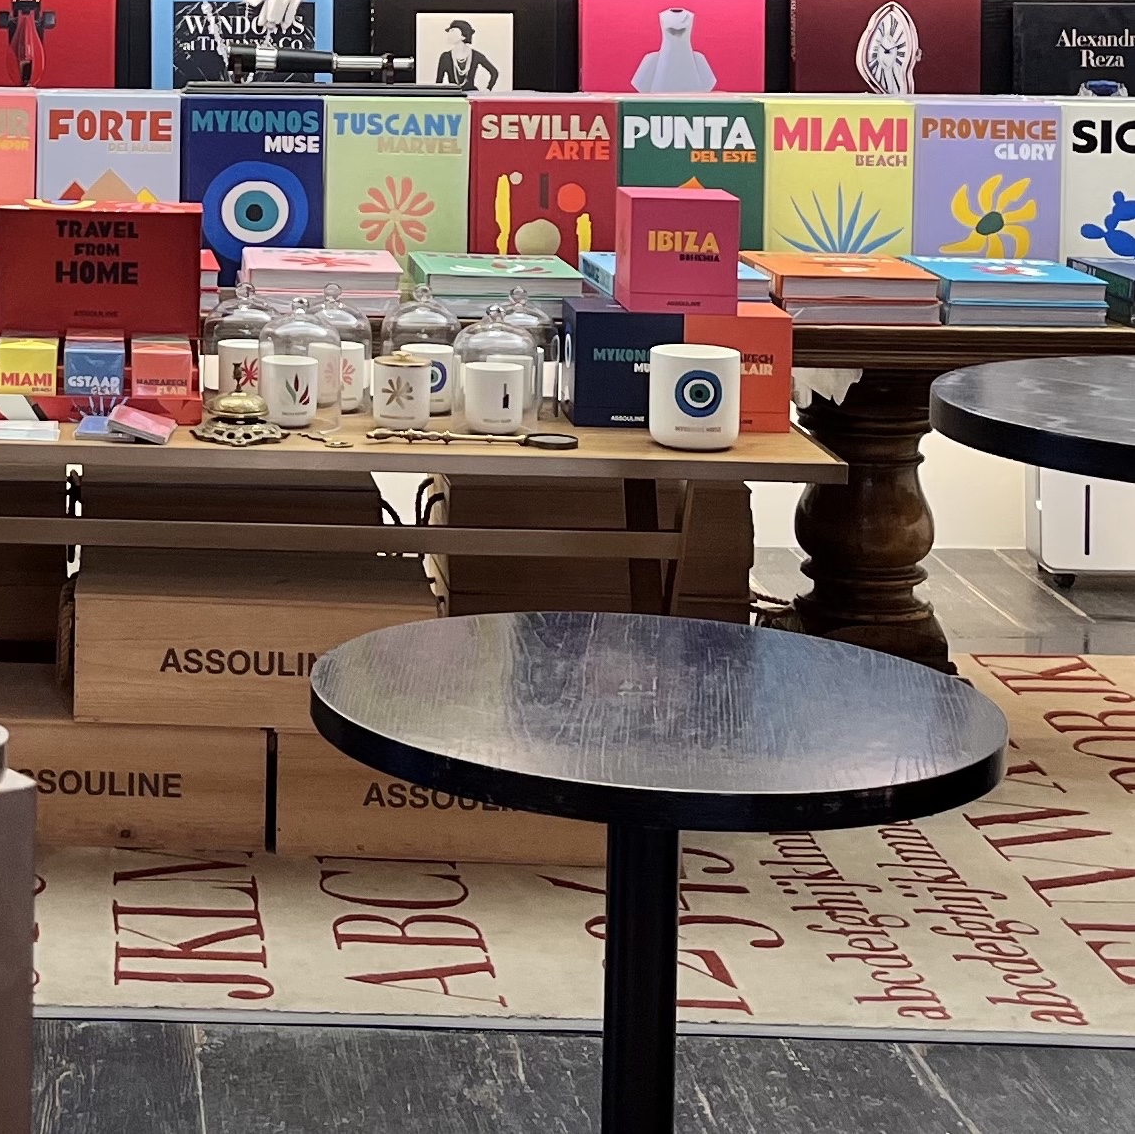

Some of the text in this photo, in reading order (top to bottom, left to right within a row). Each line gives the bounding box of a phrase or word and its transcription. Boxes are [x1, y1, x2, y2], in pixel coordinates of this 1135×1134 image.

[1080, 49, 1125, 67] Reza
[49, 109, 172, 142] FORTE
[191, 110, 319, 134] MYKONOS
[336, 112, 462, 137] TUSCANY
[481, 113, 610, 141] SEVILLA
[623, 115, 756, 149] PUNTA
[921, 118, 1057, 142] PROVENCE
[264, 135, 320, 154] MUSE
[773, 116, 908, 153] MIAMI
[377, 136, 462, 155] MARVEL
[545, 140, 610, 161] ARTE
[994, 142, 1056, 162] GLORY
[690, 150, 757, 163] DEL ESTE
[855, 153, 908, 168] BEACH
[56, 219, 139, 239] TRAVEL
[74, 243, 119, 256] FROM
[647, 230, 720, 253] IBIZA
[55, 260, 139, 285] HOME
[1, 372, 53, 388] MIAMI
[67, 375, 120, 388] GSTAAD
[136, 378, 187, 387] MARRAKECH
[156, 386, 187, 396] FLAIR
[610, 414, 645, 422] ASSOULINE
